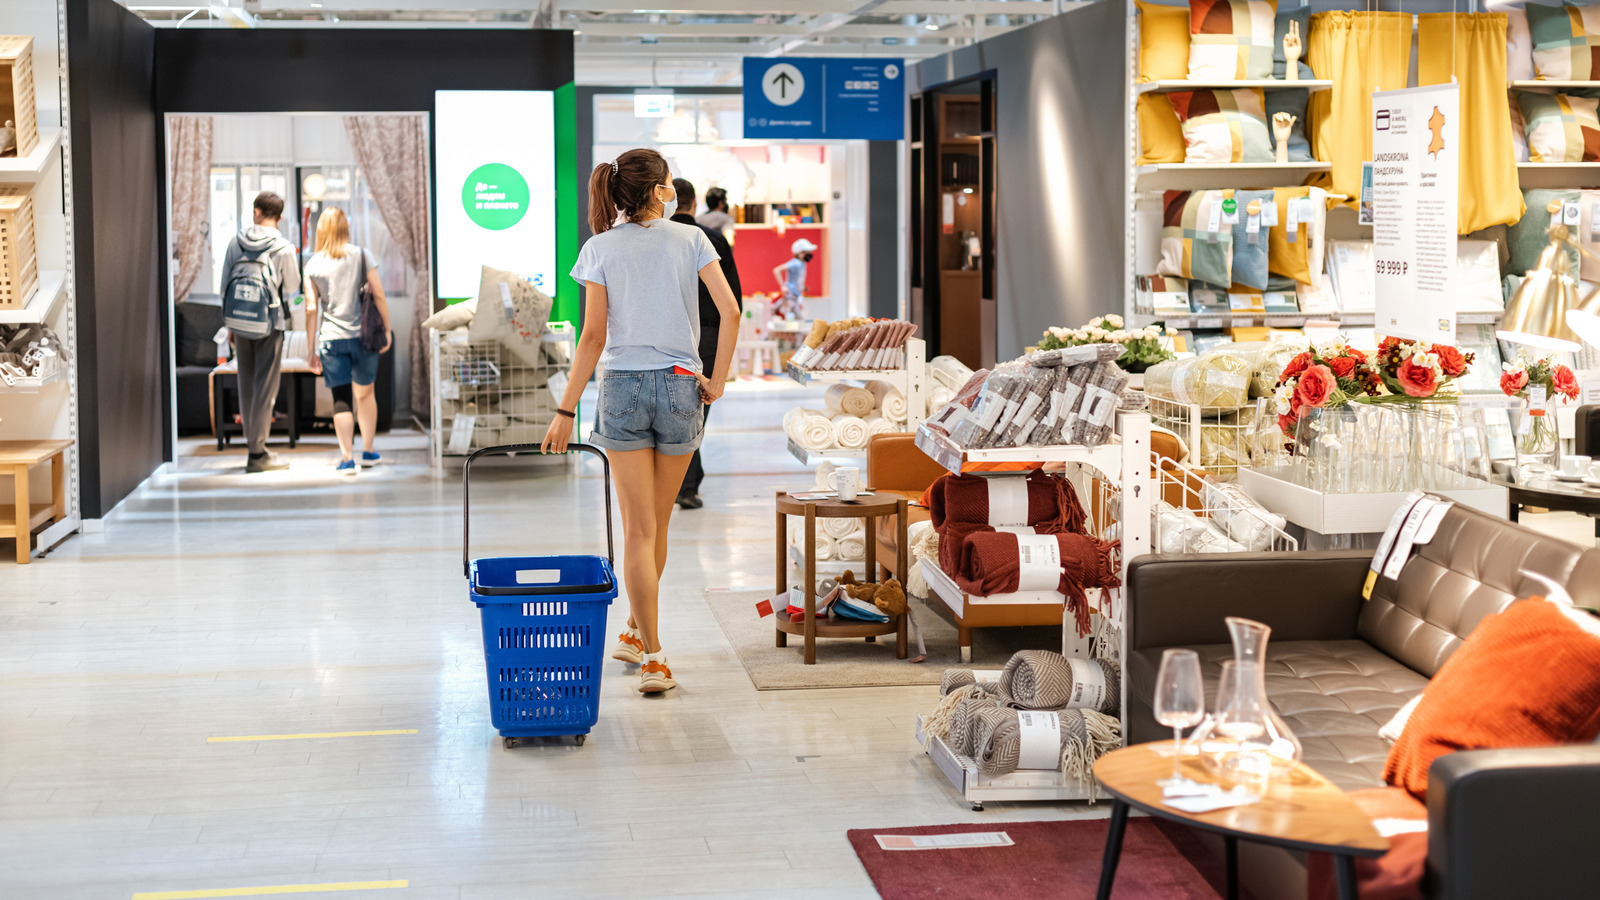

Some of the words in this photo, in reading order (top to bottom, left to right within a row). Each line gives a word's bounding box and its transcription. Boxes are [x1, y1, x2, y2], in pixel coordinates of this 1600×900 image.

[1374, 152, 1409, 162] LANDSKRONA
[1376, 259, 1385, 274] 69
[1387, 260, 1401, 275] 999
